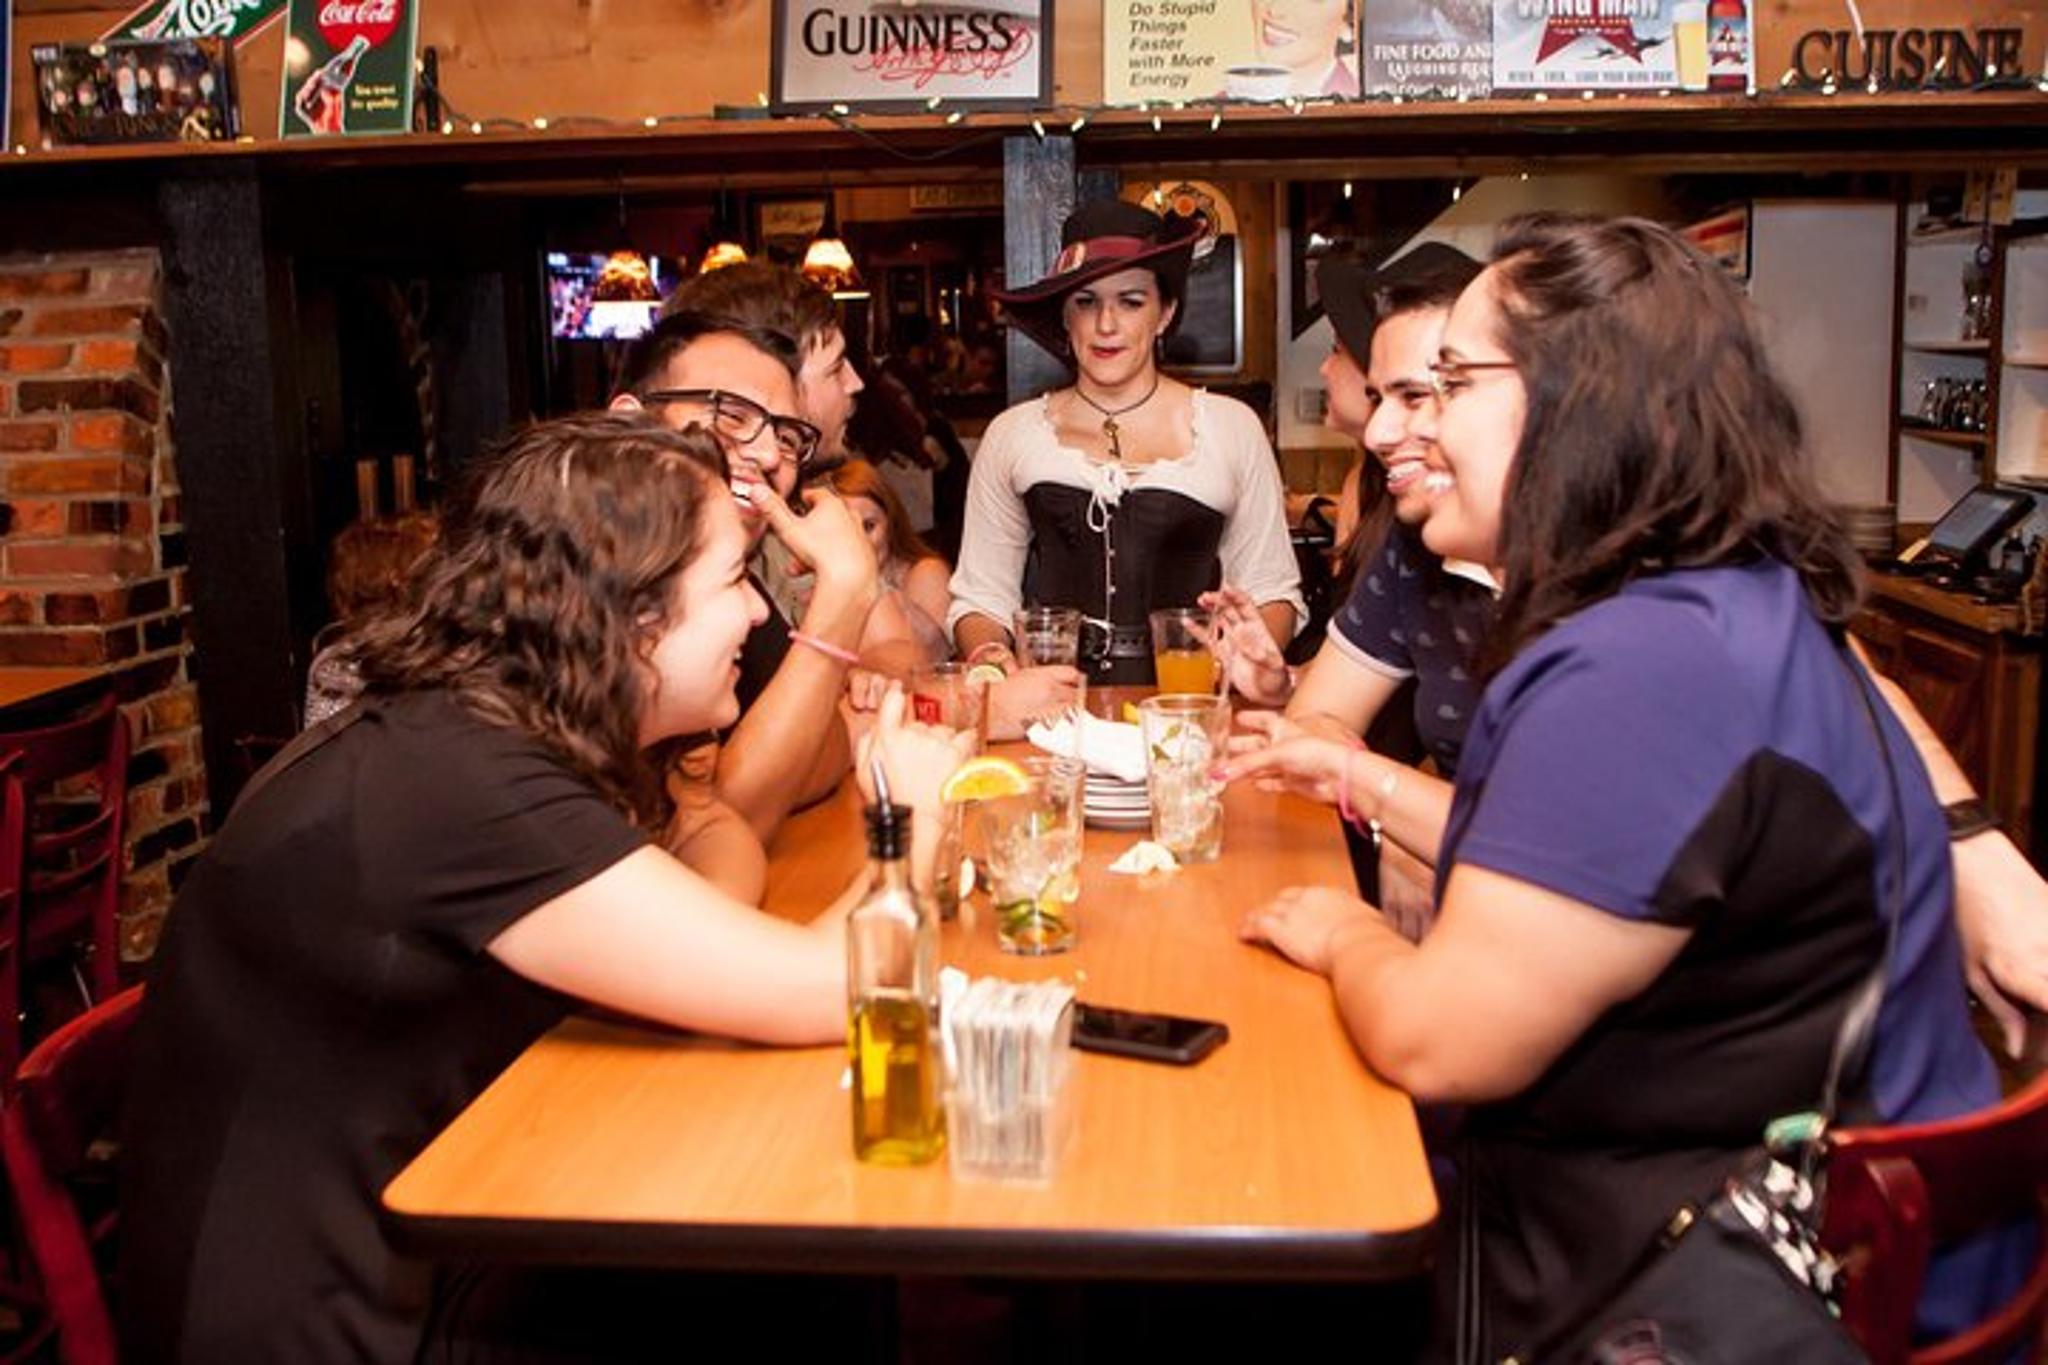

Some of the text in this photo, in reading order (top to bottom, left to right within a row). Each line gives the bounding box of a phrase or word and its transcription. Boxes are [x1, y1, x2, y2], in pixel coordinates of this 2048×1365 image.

[1129, 0, 1216, 19] Do Stupid
[803, 8, 1014, 56] GUINNESS
[1129, 20, 1187, 35] Things
[1129, 37, 1184, 51] Faster
[1373, 44, 1408, 61] FINE
[1412, 42, 1459, 61] FOOD
[1129, 54, 1215, 69] with More
[1793, 28, 2023, 86] CUISINE
[1129, 73, 1191, 89] Energy
